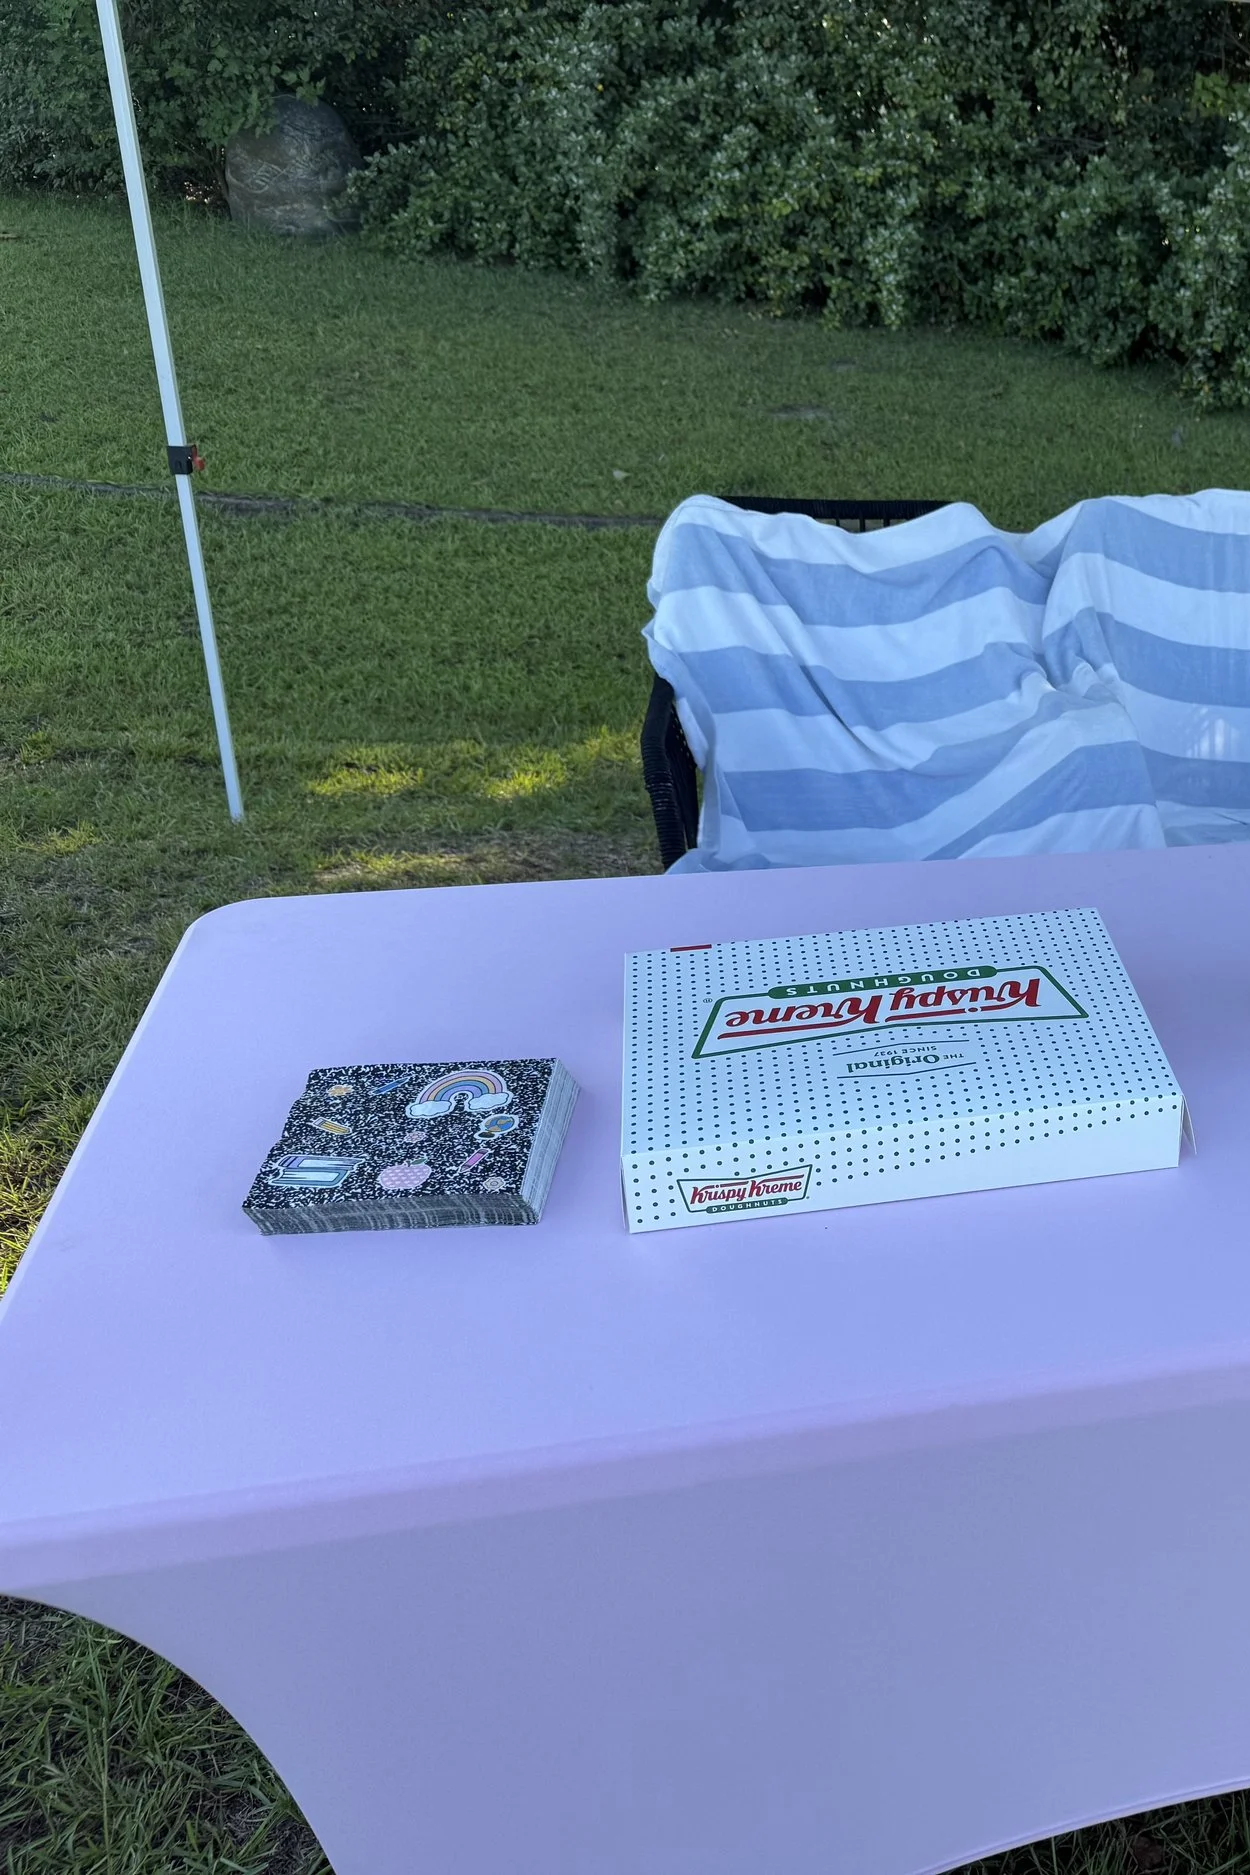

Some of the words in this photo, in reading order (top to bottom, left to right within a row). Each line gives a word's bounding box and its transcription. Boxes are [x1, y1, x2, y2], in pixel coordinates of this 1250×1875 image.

[785, 969, 982, 996] DOUGHNUTS
[885, 978, 1042, 1022] Krispy
[717, 995, 881, 1040] Kreme
[873, 1049, 899, 1057] 1937
[901, 1045, 937, 1054] SINCE
[846, 1053, 940, 1073] Original
[689, 1180, 750, 1205] Krispy
[748, 1173, 805, 1199] Kreme
[711, 1199, 783, 1213] DOUGHNUTS
